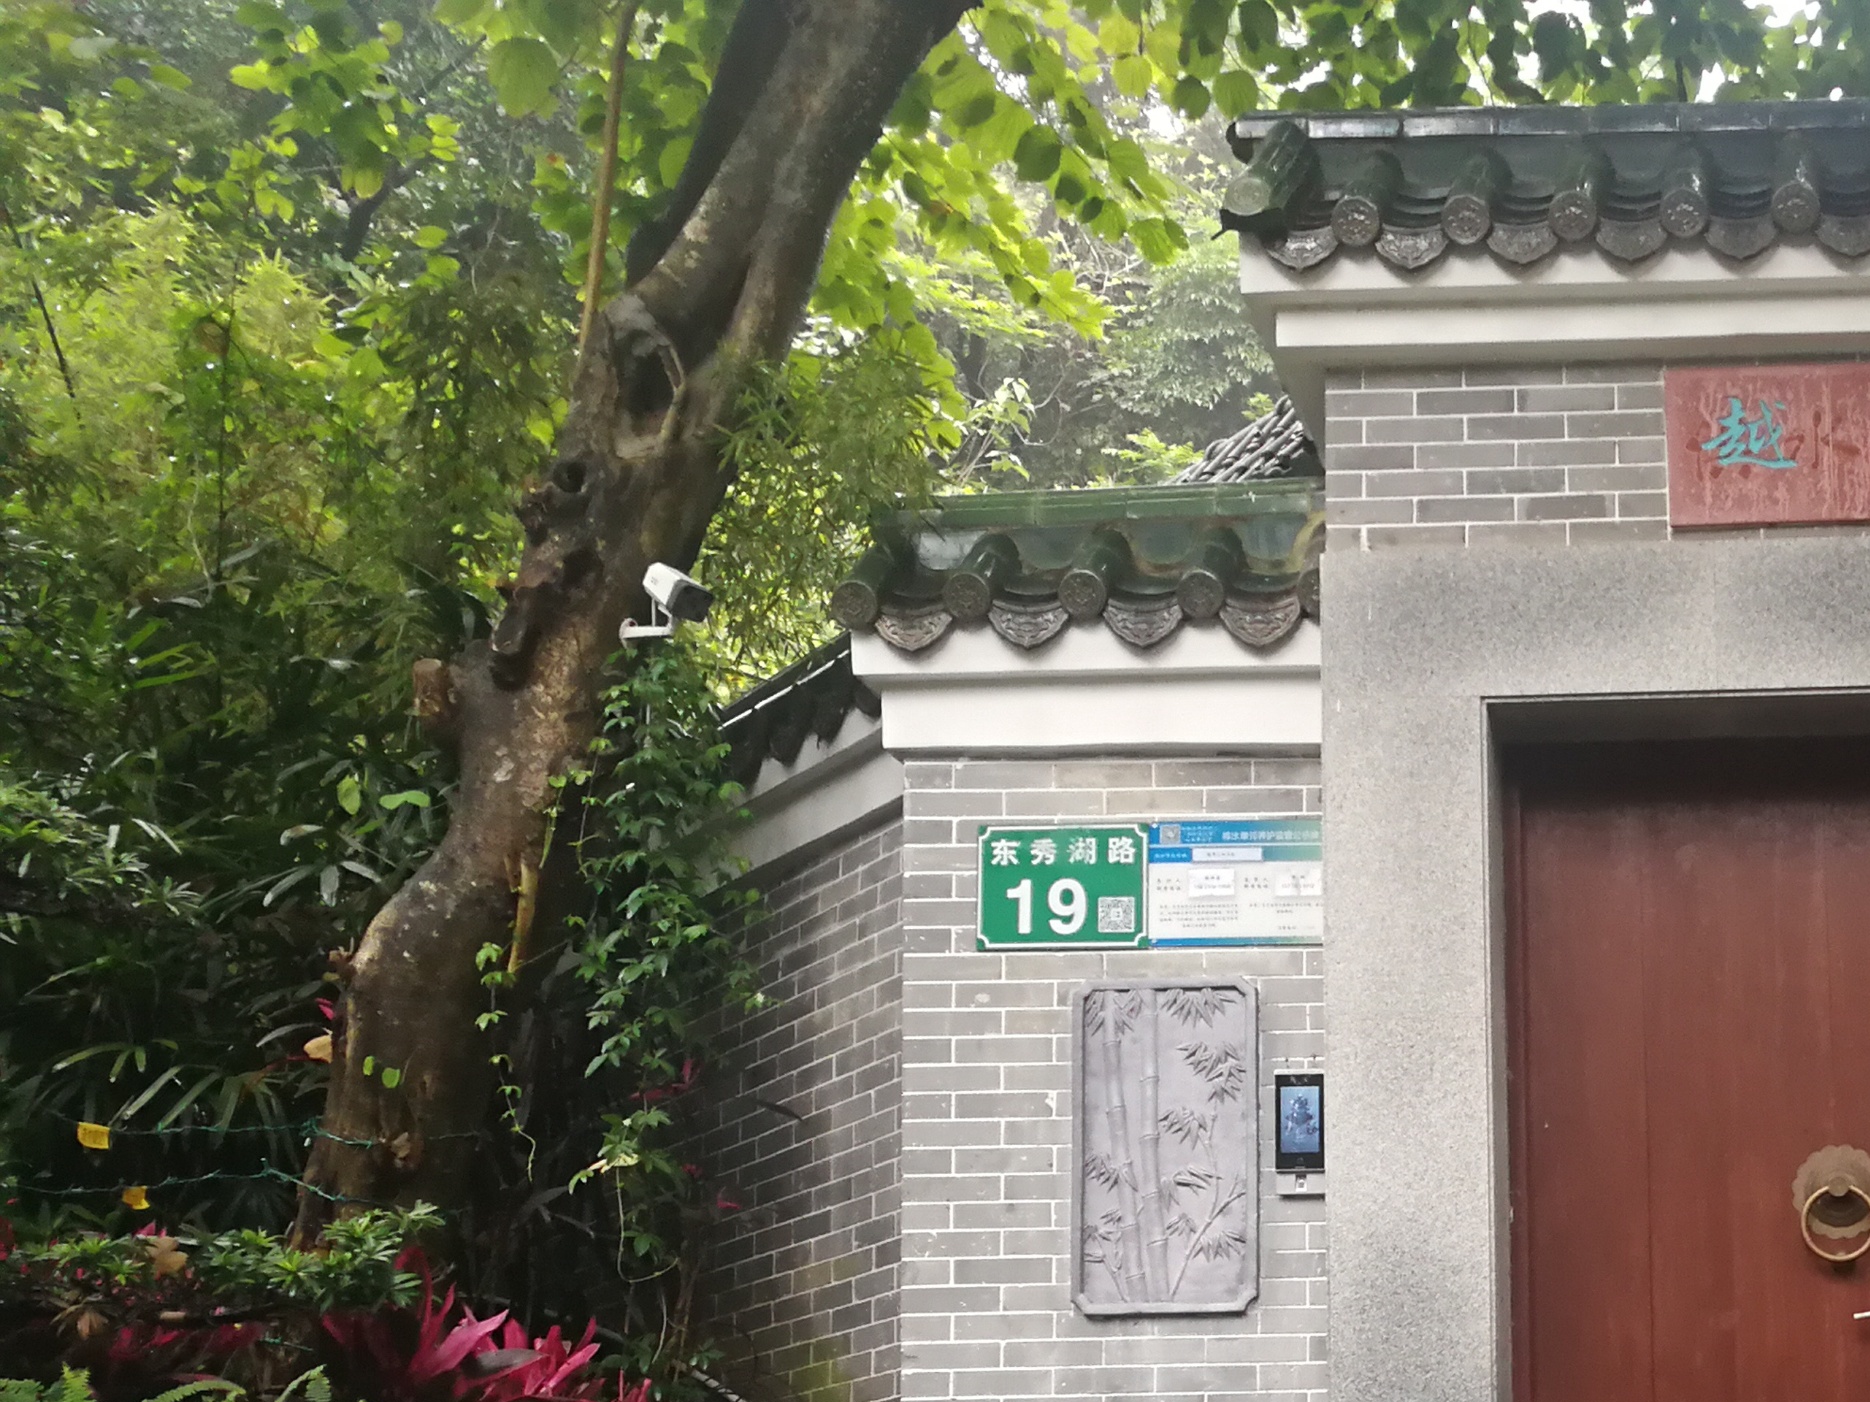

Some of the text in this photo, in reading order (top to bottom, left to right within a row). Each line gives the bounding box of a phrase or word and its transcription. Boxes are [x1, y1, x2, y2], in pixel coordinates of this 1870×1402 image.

[990, 836, 1136, 866] 东秀湖路
[1006, 877, 1088, 935] 19
